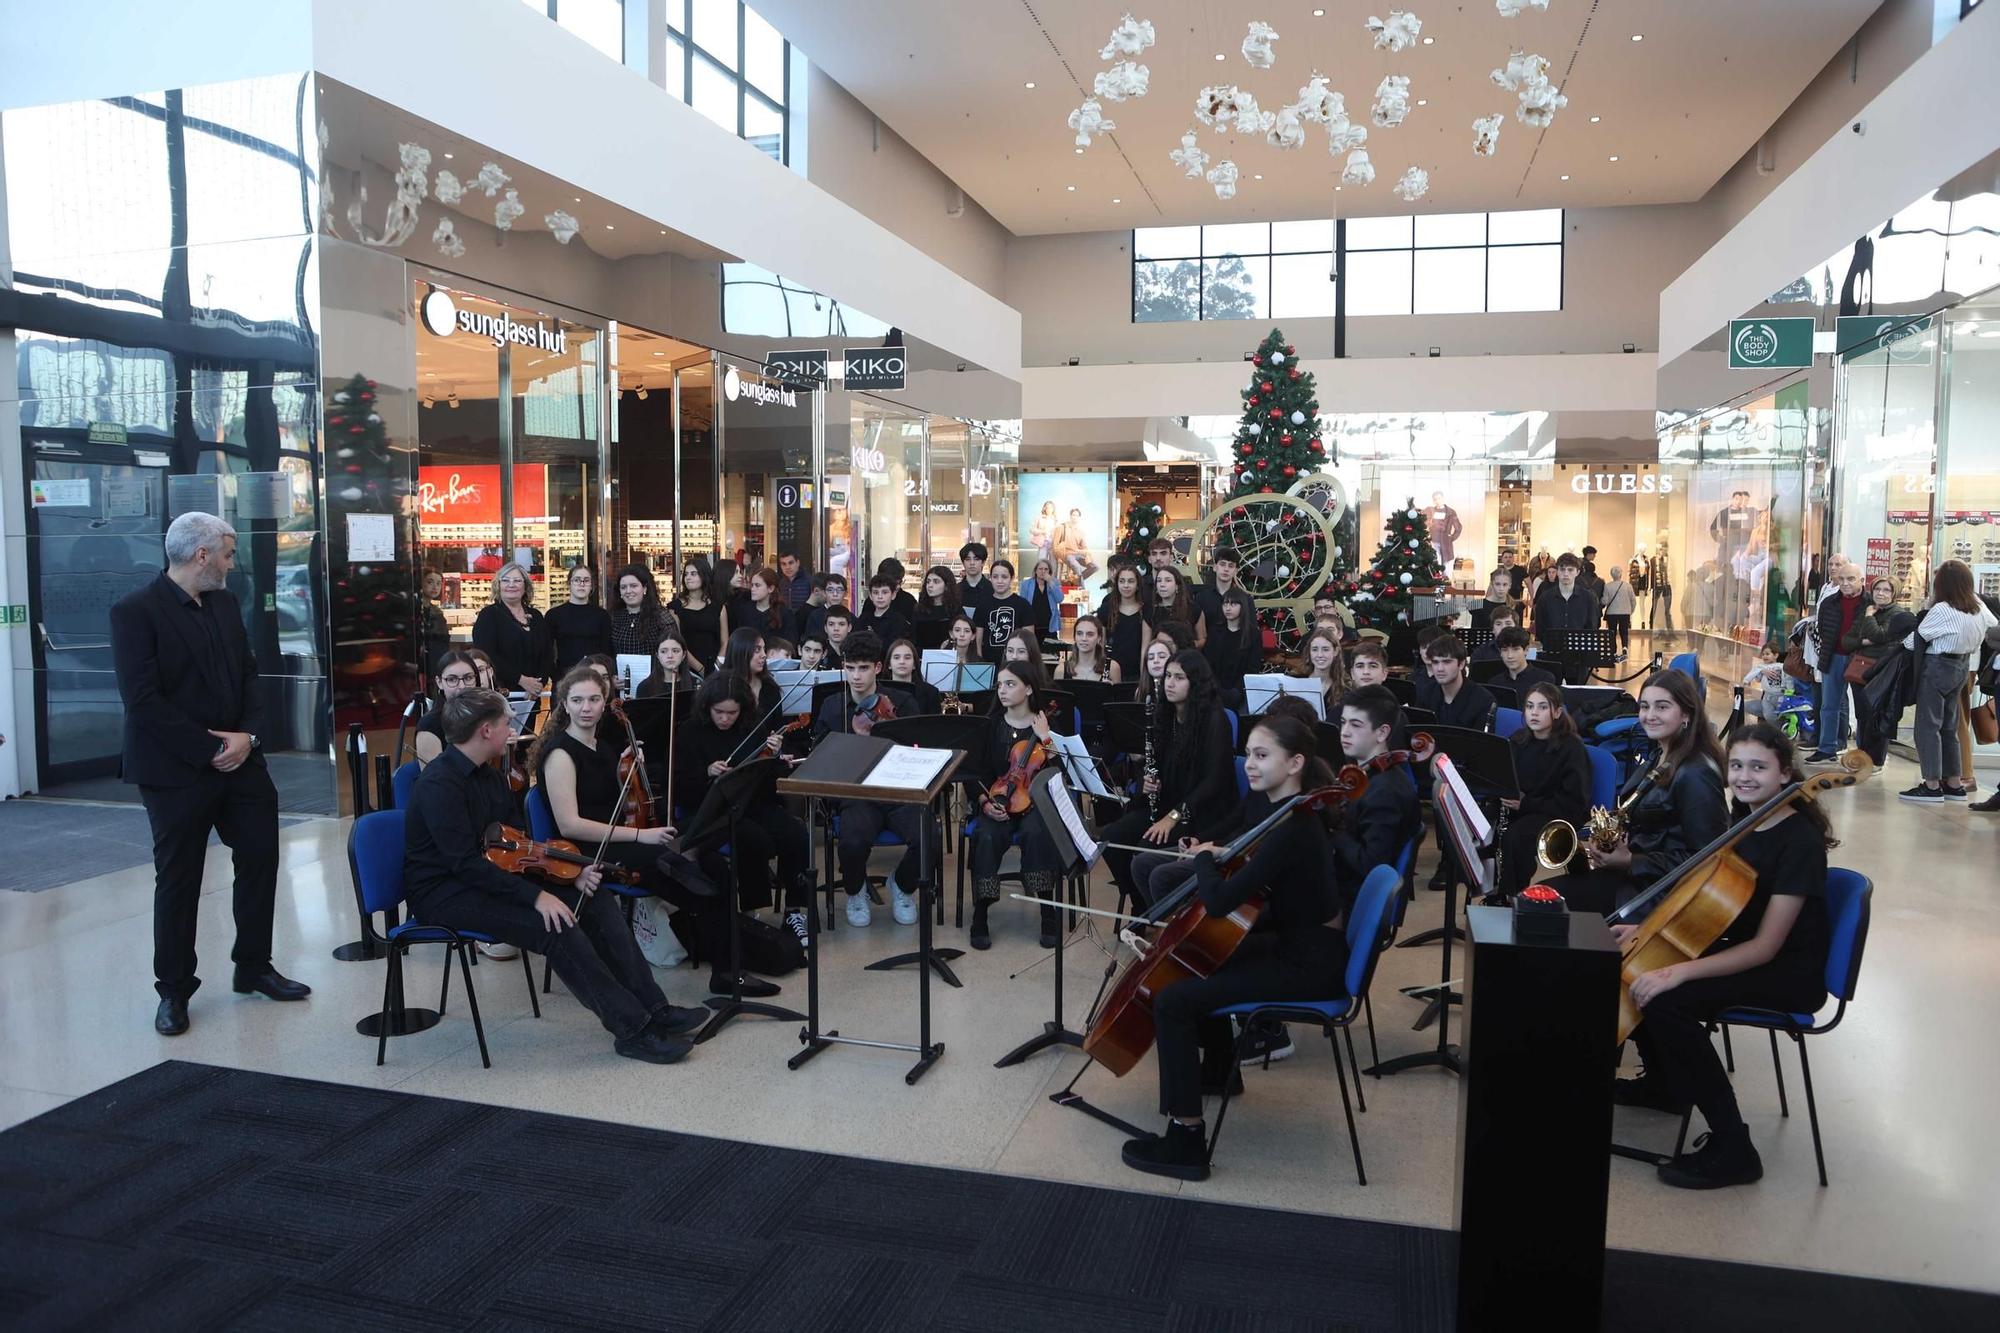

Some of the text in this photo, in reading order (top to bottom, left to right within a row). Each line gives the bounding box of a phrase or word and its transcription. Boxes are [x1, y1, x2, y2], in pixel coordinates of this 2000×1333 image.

[459, 310, 567, 354] sunglass hut
[1744, 349, 1768, 357] SHOP
[846, 358, 904, 375] KIKO
[740, 379, 780, 406] sunglass
[780, 385, 797, 407] hut
[1571, 474, 1673, 494] GUESS
[419, 473, 480, 513] Ray-Ban
[912, 504, 959, 512] DOINGUEZ
[1875, 549, 1890, 561] PAR
[1866, 566, 1889, 577] GRATIS
